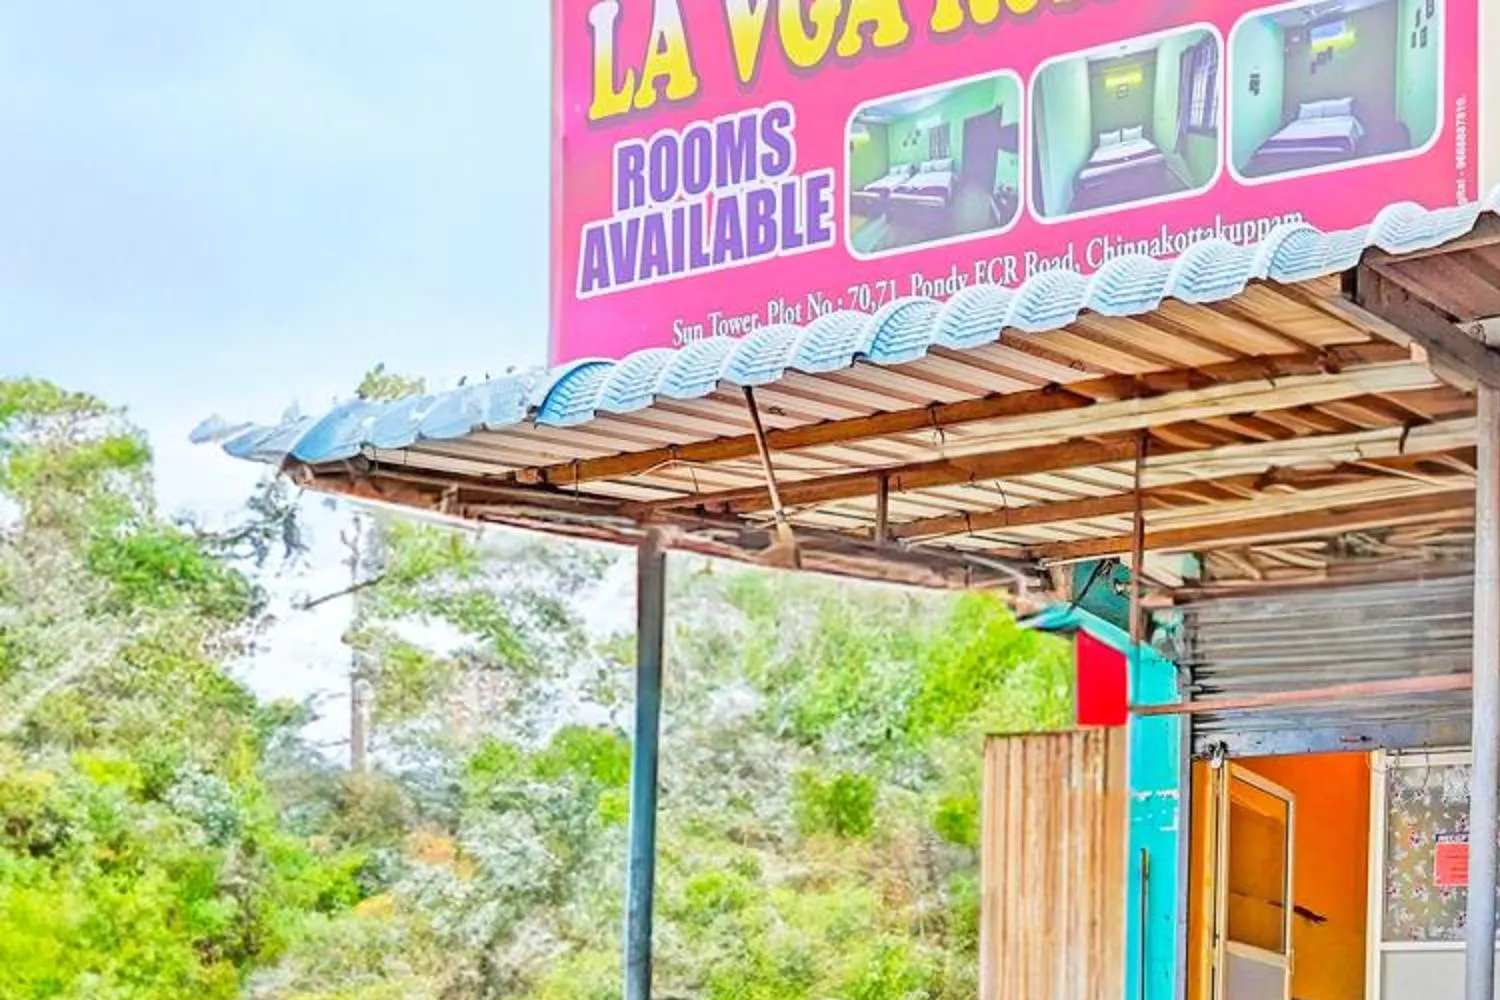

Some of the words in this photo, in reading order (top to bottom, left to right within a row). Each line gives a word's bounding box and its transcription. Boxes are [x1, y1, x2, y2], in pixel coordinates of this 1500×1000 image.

[588, 0, 698, 120] LA
[614, 104, 793, 213] ROOMS
[578, 172, 834, 295] AVAILABLE
[672, 319, 704, 346] Sun
[767, 298, 801, 325] Plot
[911, 265, 969, 298] Pondy
[974, 256, 1018, 287] ECR
